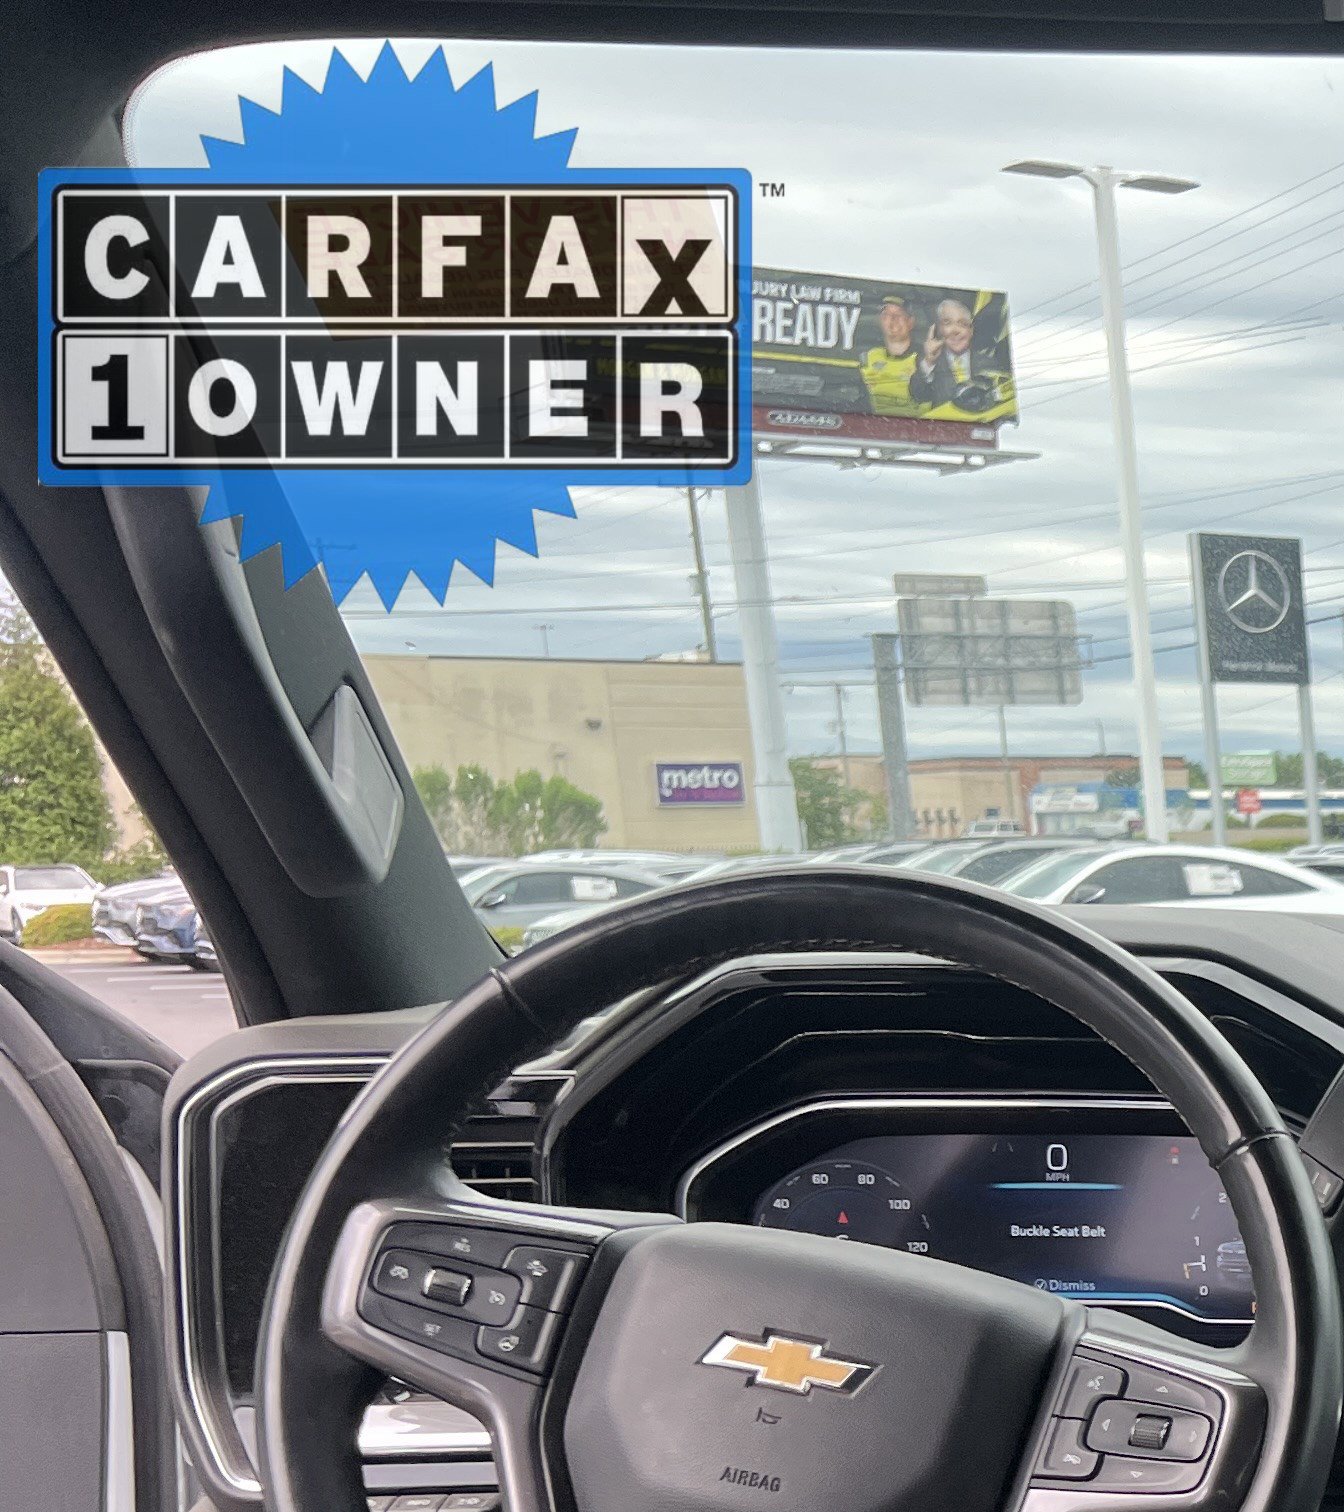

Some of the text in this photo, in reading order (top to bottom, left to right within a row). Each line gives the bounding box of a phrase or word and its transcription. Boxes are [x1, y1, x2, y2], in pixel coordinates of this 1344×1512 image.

[752, 297, 861, 351] READY
[1046, 1143, 1069, 1171] 0
[811, 1173, 875, 1185] 60 80
[1045, 1172, 1070, 1182] MPH
[773, 1198, 790, 1209] 40
[1218, 1192, 1228, 1203] 2
[888, 1199, 911, 1210] 100
[1010, 1224, 1107, 1238] Buckle Seat Belt
[907, 1242, 929, 1253] 120
[1050, 1279, 1096, 1291] Dismiss
[1199, 1285, 1209, 1297] 0
[719, 1466, 781, 1492] AIRBAG
